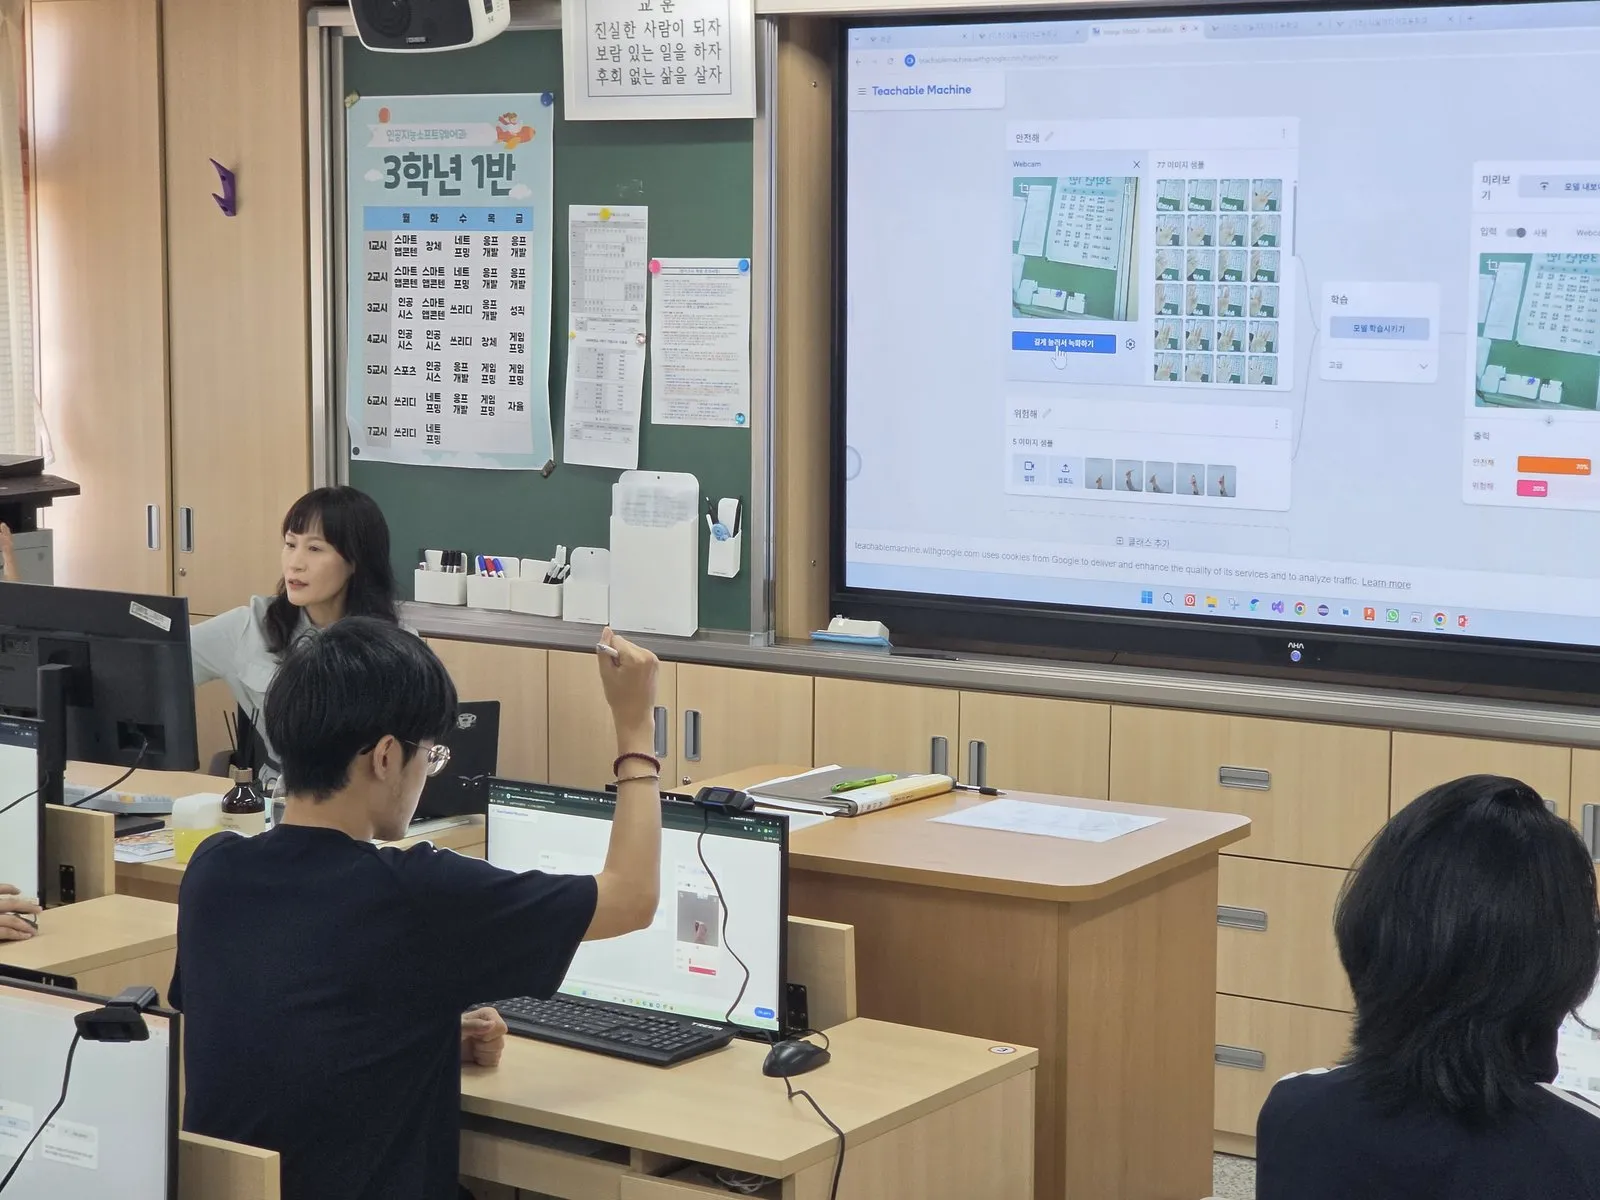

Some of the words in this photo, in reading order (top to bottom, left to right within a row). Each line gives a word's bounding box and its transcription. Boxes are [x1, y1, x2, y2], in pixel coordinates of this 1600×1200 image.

[595, 21, 636, 39] 진실한
[644, 19, 684, 38] 사람이
[693, 18, 721, 37] 되자
[596, 44, 622, 62] 보람
[628, 44, 654, 62] 있는
[660, 43, 686, 62] 일을
[694, 41, 722, 60] 하자
[596, 68, 622, 86] 후회
[629, 67, 655, 86] 없는
[660, 66, 687, 85] 삶을
[695, 65, 722, 84] 살자
[872, 86, 924, 96] Teachable
[927, 84, 971, 95] Machine
[1016, 134, 1040, 143] 안전해
[383, 151, 462, 196] 3학년
[471, 153, 516, 196] 1반
[1482, 175, 1510, 185] 미리보
[430, 213, 439, 223] 화
[459, 214, 467, 223] 수
[515, 214, 523, 223] 금
[368, 241, 387, 250] 1교시
[394, 235, 417, 245] 스마트
[455, 236, 470, 245] 네트
[483, 236, 498, 246] 응프
[511, 236, 526, 246] 응프
[454, 248, 470, 258] 프밍
[483, 248, 498, 258] 개발
[511, 248, 526, 258] 개발
[367, 272, 388, 282] 2교시
[394, 266, 417, 276] 스마트
[422, 267, 445, 276] 스마트
[454, 267, 470, 277] 네트
[483, 268, 497, 278] 응프
[511, 268, 525, 278] 응프
[454, 280, 470, 289] 프밍
[482, 280, 498, 289] 개발
[510, 280, 526, 289] 개발
[367, 303, 388, 313] 3교시
[398, 297, 413, 307] 인공
[422, 298, 445, 308] 스마트
[450, 305, 473, 315] 쓰리디
[483, 299, 497, 310] 응프
[511, 306, 525, 316] 성직
[1331, 295, 1348, 305] 학습
[398, 310, 413, 320] 시스
[482, 311, 497, 321] 개발
[1370, 325, 1405, 333] 학습시키기
[367, 334, 387, 344] 4교시
[398, 329, 413, 339] 인공
[426, 330, 441, 340] 인공
[450, 336, 472, 346] 쓰리디
[509, 332, 525, 342] 게임
[398, 340, 413, 350] 시스
[426, 341, 441, 351] 시스
[509, 343, 524, 354] 프밍
[367, 365, 387, 375] 5교시
[394, 366, 416, 376] 스포츠
[426, 361, 441, 371] 인공
[454, 362, 468, 372] 응프
[481, 363, 496, 373] 게임
[509, 364, 524, 374] 게임
[426, 373, 441, 382] 시스
[453, 373, 469, 383] 개발
[481, 374, 496, 384] 프밍
[508, 376, 524, 386] 프밍
[367, 396, 387, 405] 6교시
[394, 397, 416, 407] 쓰리디
[426, 393, 441, 402] 네트
[454, 393, 468, 403] 응프
[481, 395, 496, 405] 게임
[426, 404, 441, 414] 프밍
[453, 405, 468, 415] 개발
[481, 406, 495, 416] 프밍
[1014, 409, 1037, 418] 위험해
[367, 427, 387, 436] 7교시
[394, 428, 416, 438] 쓰리디
[426, 424, 441, 433] 네트
[426, 435, 441, 445] 프밍
[1019, 438, 1038, 446] 이미지
[982, 550, 999, 560] uses
[1002, 551, 1030, 562] cookies
[1032, 553, 1050, 563] from
[1052, 555, 1079, 567] Google
[1080, 556, 1088, 566] to
[1090, 557, 1116, 568] deliver
[1118, 560, 1133, 569] and
[1135, 562, 1169, 572] enhance
[1171, 565, 1183, 573] the
[1186, 566, 1211, 576] quality
[1214, 567, 1222, 575] of
[1223, 568, 1233, 576] its
[1234, 569, 1268, 579] services
[1271, 571, 1286, 580] and
[1289, 573, 1296, 581] to
[1299, 573, 1331, 584] analyze
[1333, 574, 1359, 585] traffic.
[1362, 577, 1387, 587] Learn
[1389, 580, 1411, 590] more
